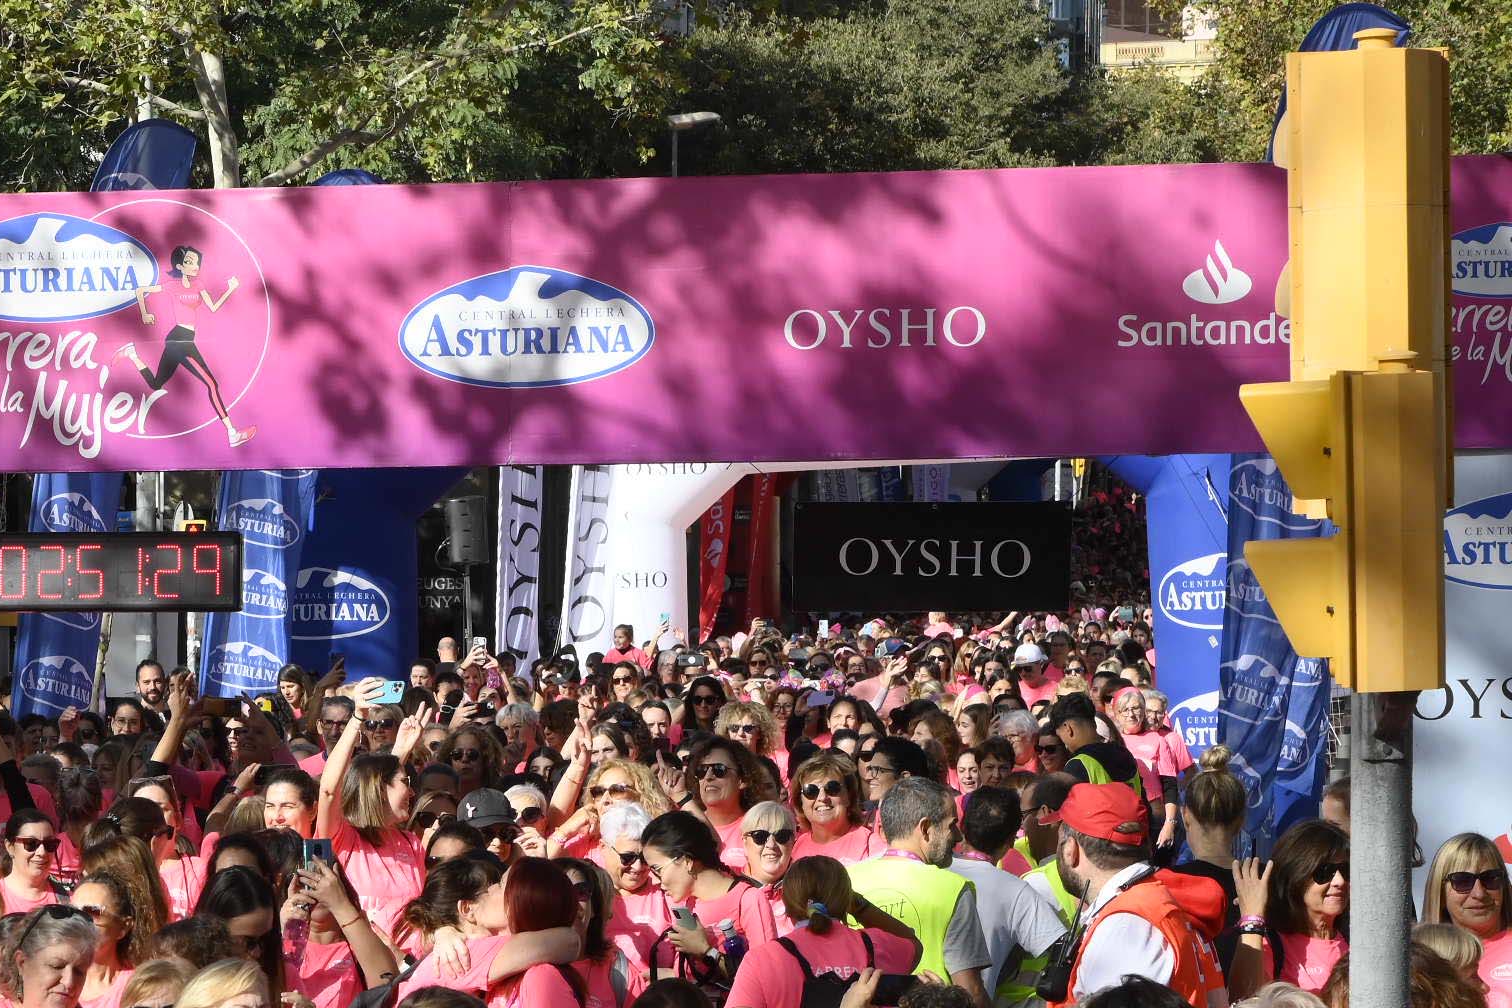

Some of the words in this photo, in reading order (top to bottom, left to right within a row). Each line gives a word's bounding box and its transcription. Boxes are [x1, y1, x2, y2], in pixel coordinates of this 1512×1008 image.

[1452, 259, 1512, 280] STUR
[458, 308, 536, 321] CENTRAL
[545, 306, 626, 319] LECHERA
[419, 313, 634, 358] ASTURIANA
[783, 305, 987, 351] OYSHO
[1117, 312, 1291, 348] Santande
[0, 374, 24, 412] la
[19, 365, 169, 459] Mujer
[506, 465, 539, 661] OYSH
[569, 465, 609, 643] OYSH
[838, 537, 1032, 578] OYSHO
[615, 570, 669, 589] SHO
[1182, 579, 1225, 589] CENTRA
[243, 594, 288, 615] URIANA
[327, 591, 377, 601] LECHERA
[291, 602, 381, 623] TURIANA
